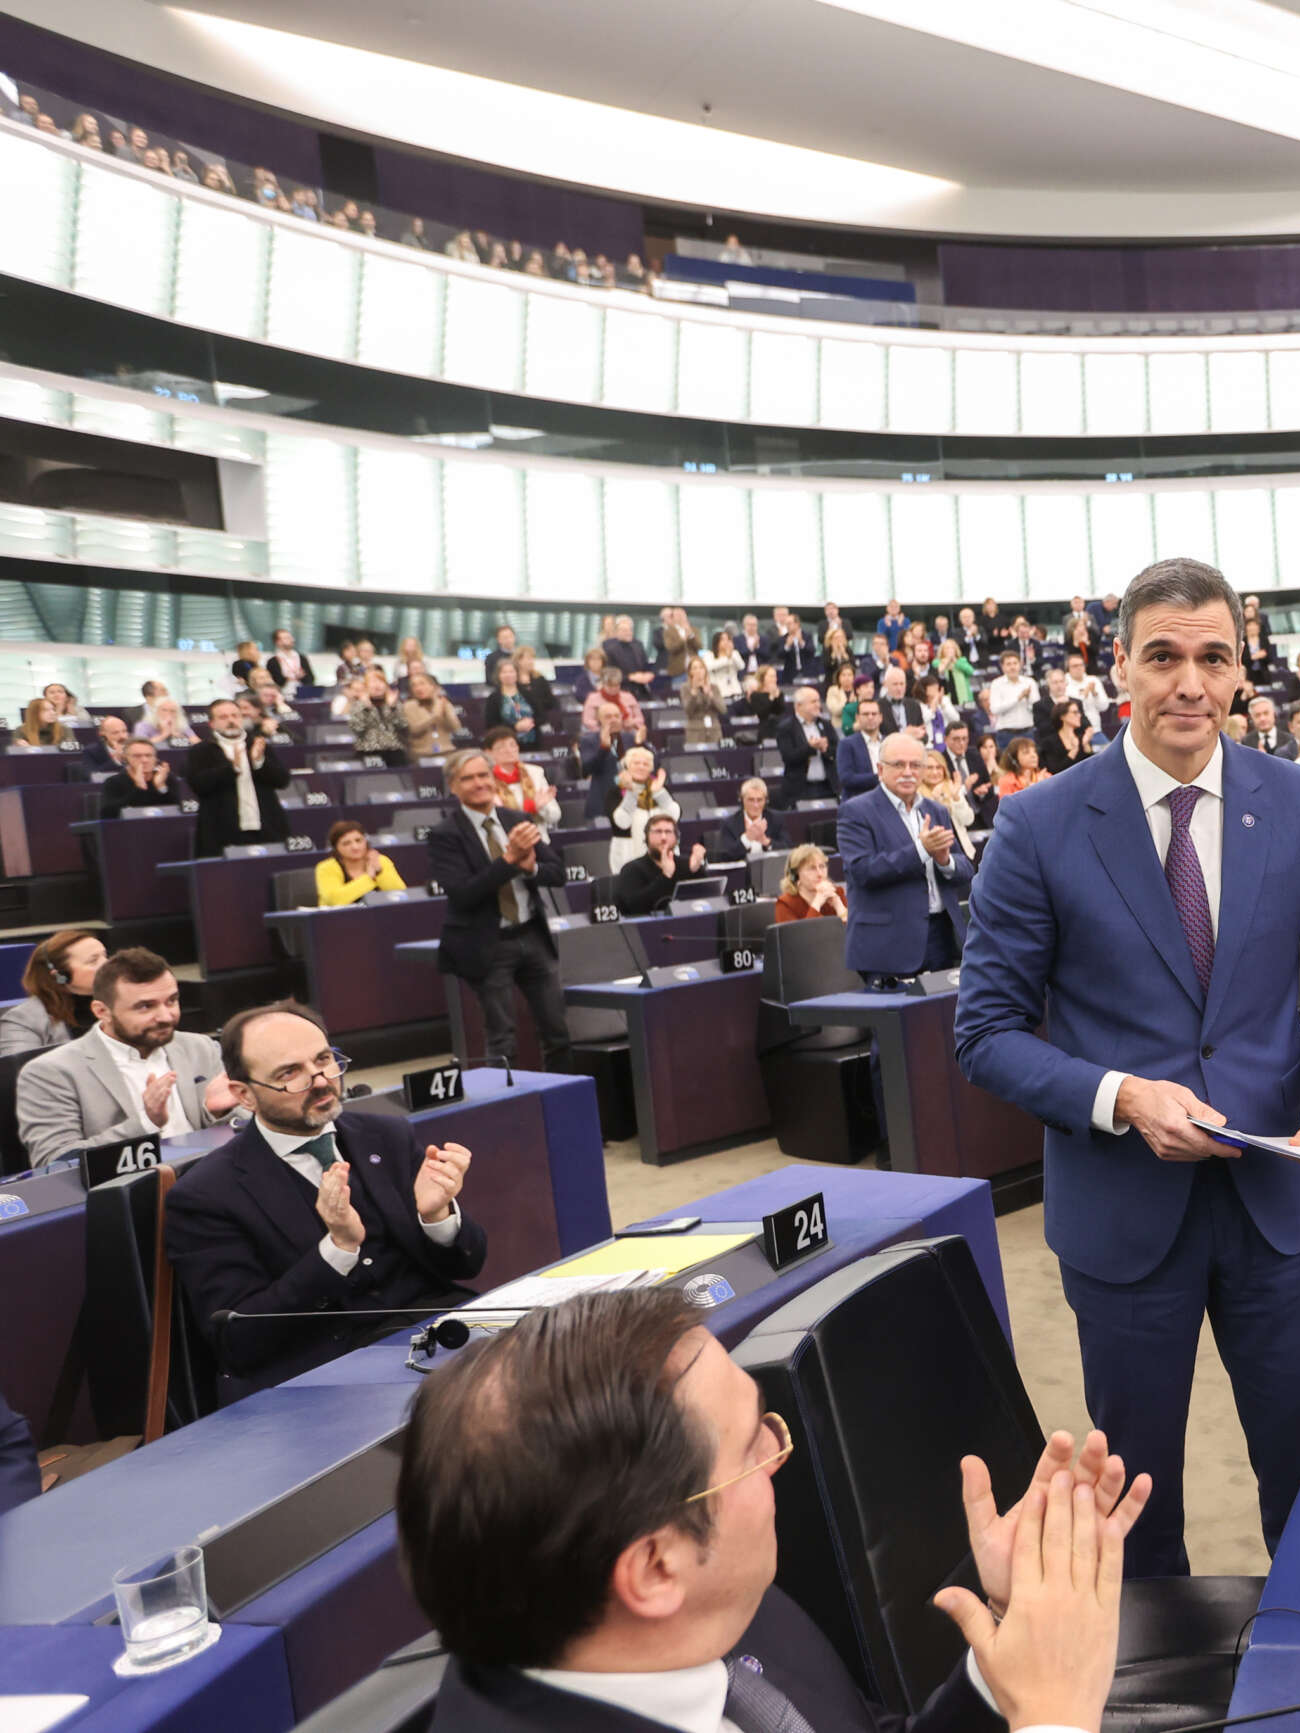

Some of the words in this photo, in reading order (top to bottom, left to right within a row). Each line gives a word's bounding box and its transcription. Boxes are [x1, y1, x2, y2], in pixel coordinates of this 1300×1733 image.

[565, 866, 585, 881] 173
[733, 888, 754, 904] 124
[594, 905, 617, 922] 123
[733, 950, 752, 969] 80
[430, 1066, 459, 1100] 47
[116, 1138, 158, 1175] 46
[794, 1202, 824, 1251] 24
